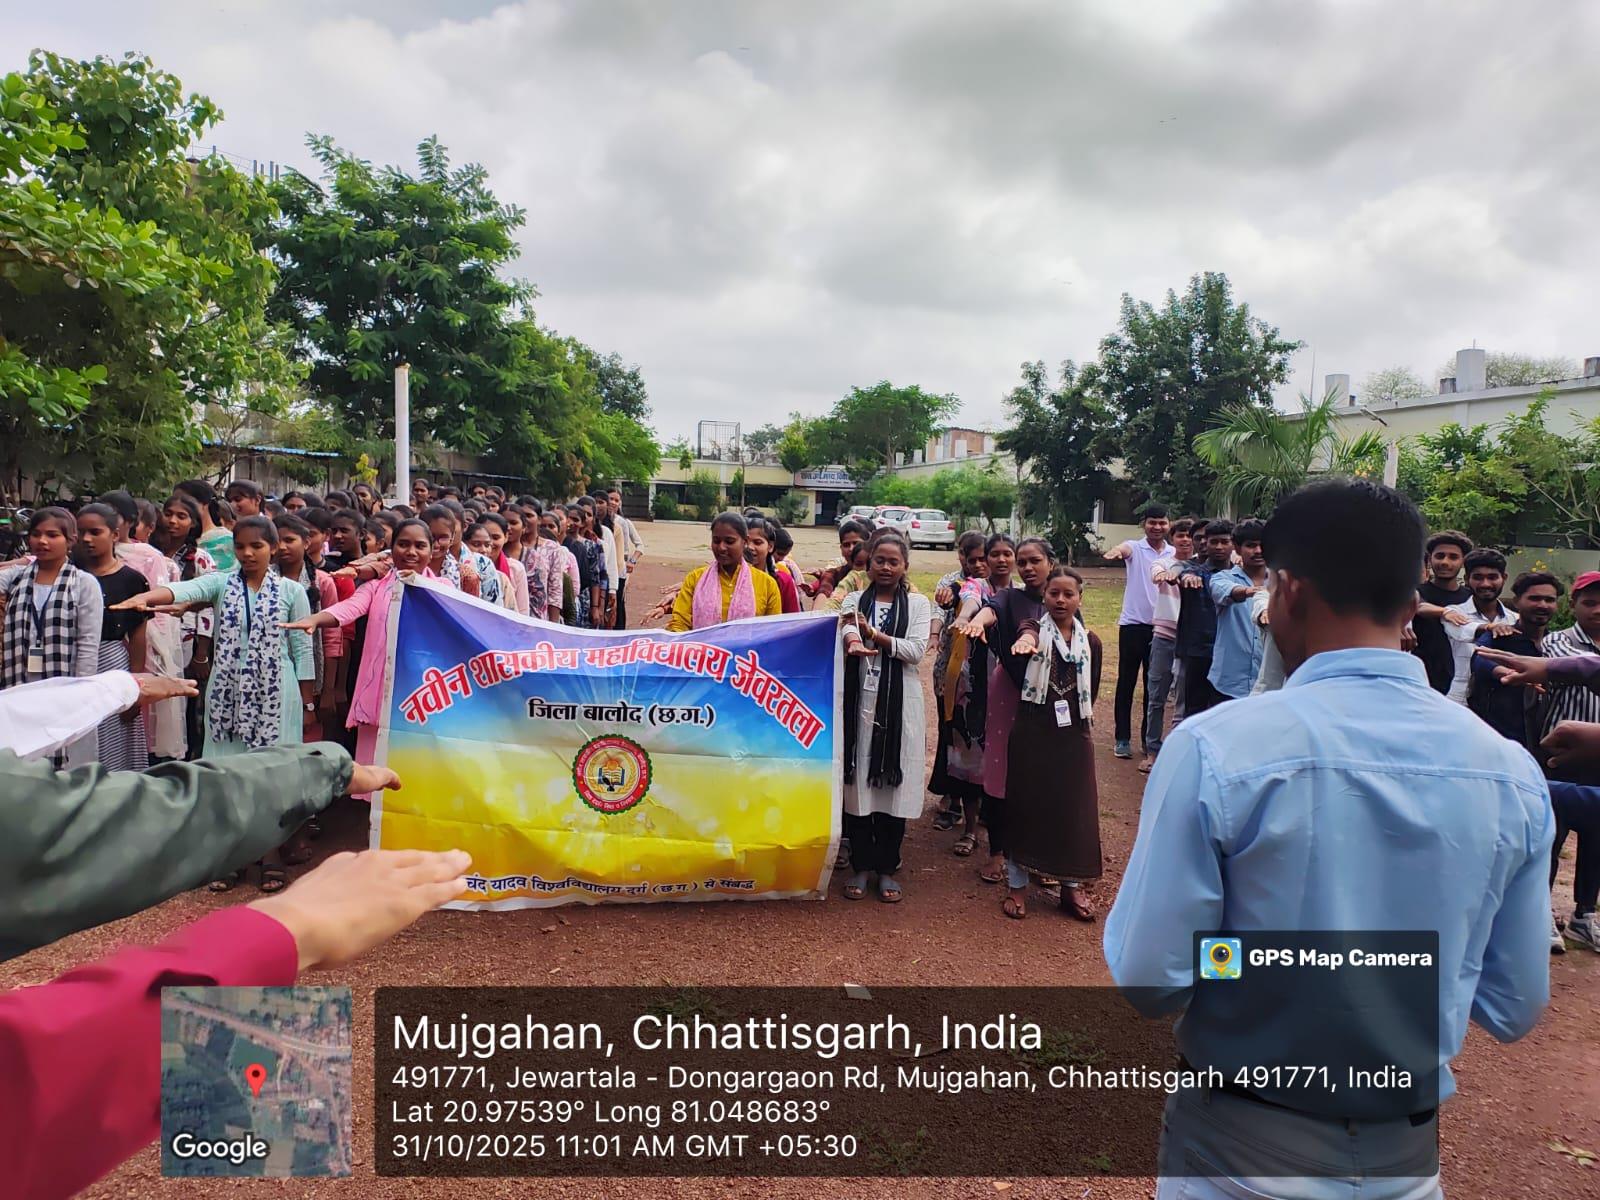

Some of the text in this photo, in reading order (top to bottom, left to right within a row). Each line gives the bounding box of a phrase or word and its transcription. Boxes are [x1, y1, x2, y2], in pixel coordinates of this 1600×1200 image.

[401, 668, 471, 724] नवीन
[470, 642, 579, 687] शासकीय
[733, 650, 824, 747] जेवरतला
[528, 698, 715, 728] जिला बालोद (छ.ग.)
[465, 873, 488, 894] चंद
[490, 876, 528, 891] यादव
[703, 878, 716, 888] से
